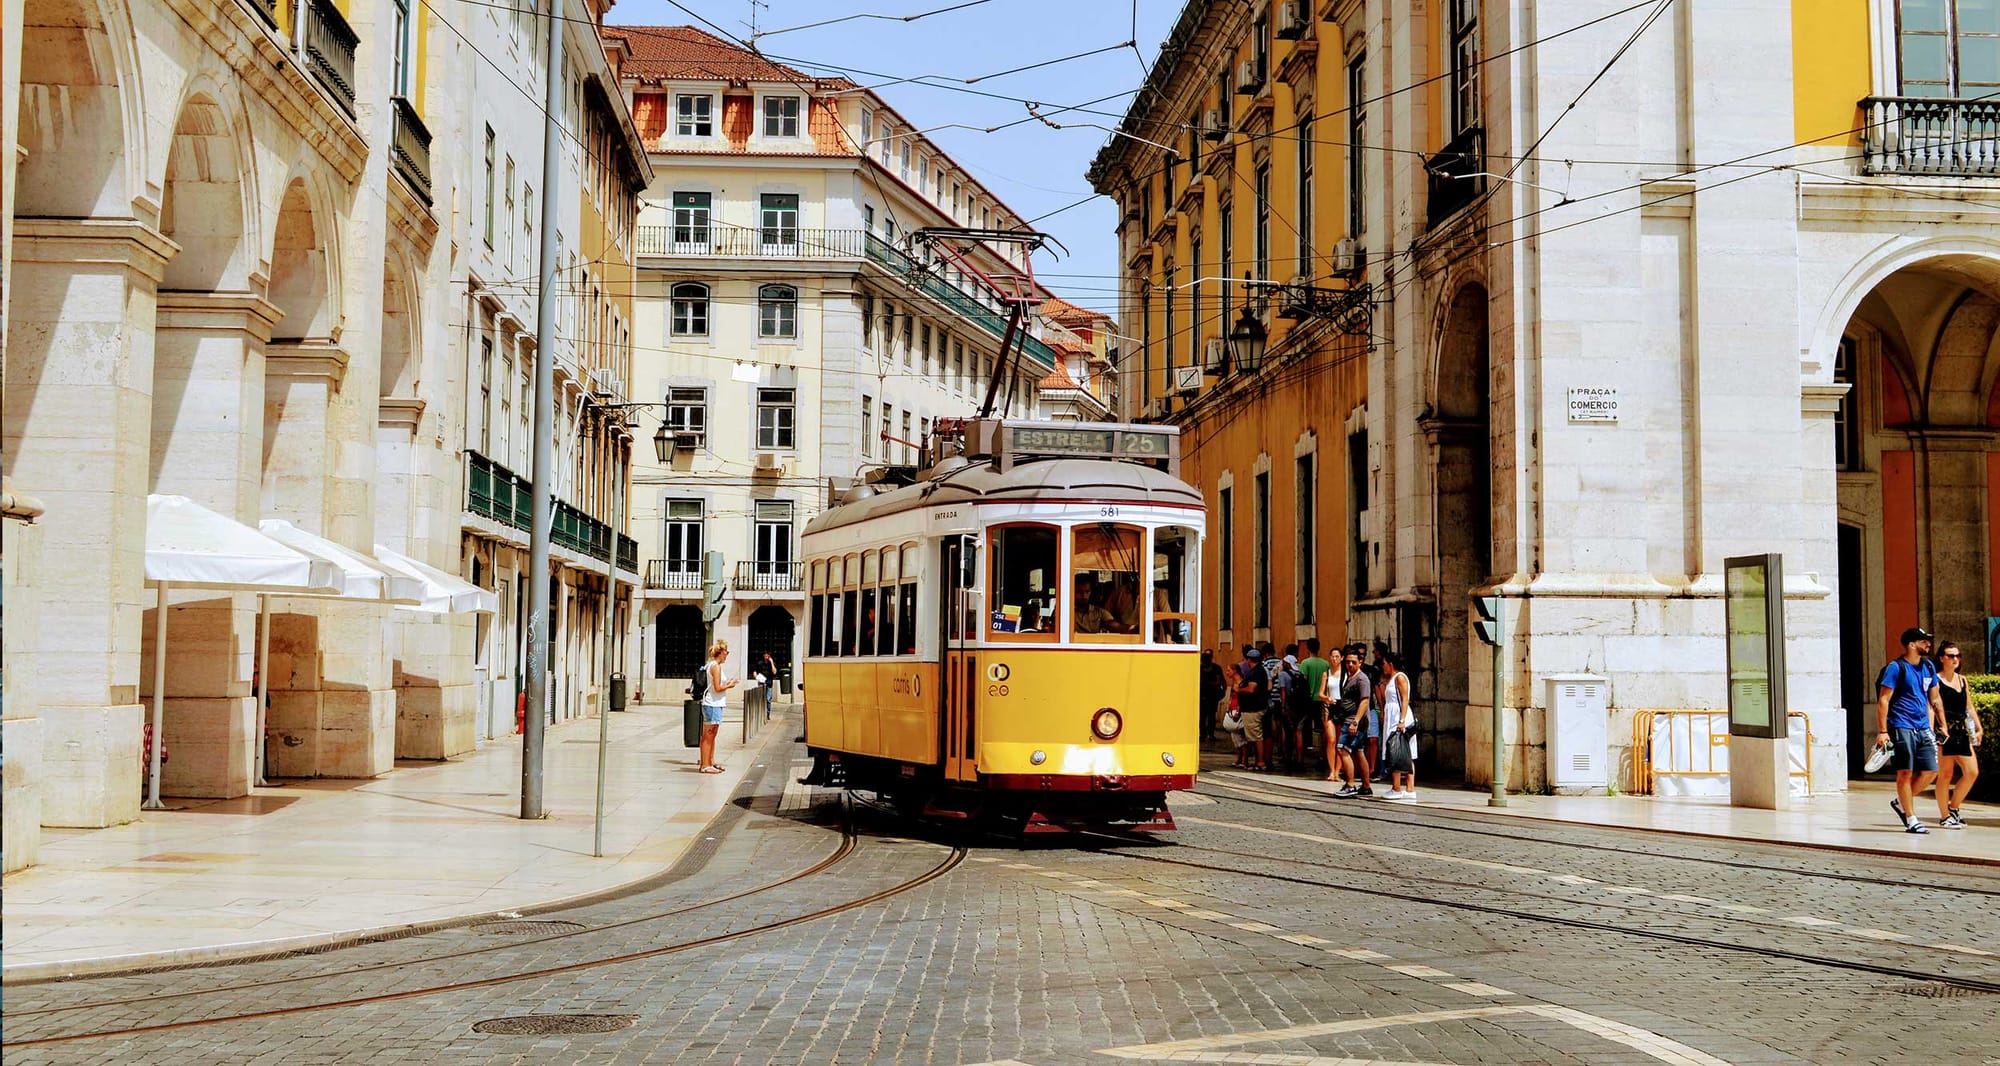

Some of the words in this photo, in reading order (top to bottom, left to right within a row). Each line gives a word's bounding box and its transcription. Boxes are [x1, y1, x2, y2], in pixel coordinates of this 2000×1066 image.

[1577, 388, 1610, 397] PRAÇA
[1019, 430, 1107, 447] ESTRELA
[1125, 433, 1154, 452] 25
[934, 511, 958, 520] ENTRADA
[1100, 506, 1119, 517] 581
[992, 621, 1003, 630] 01
